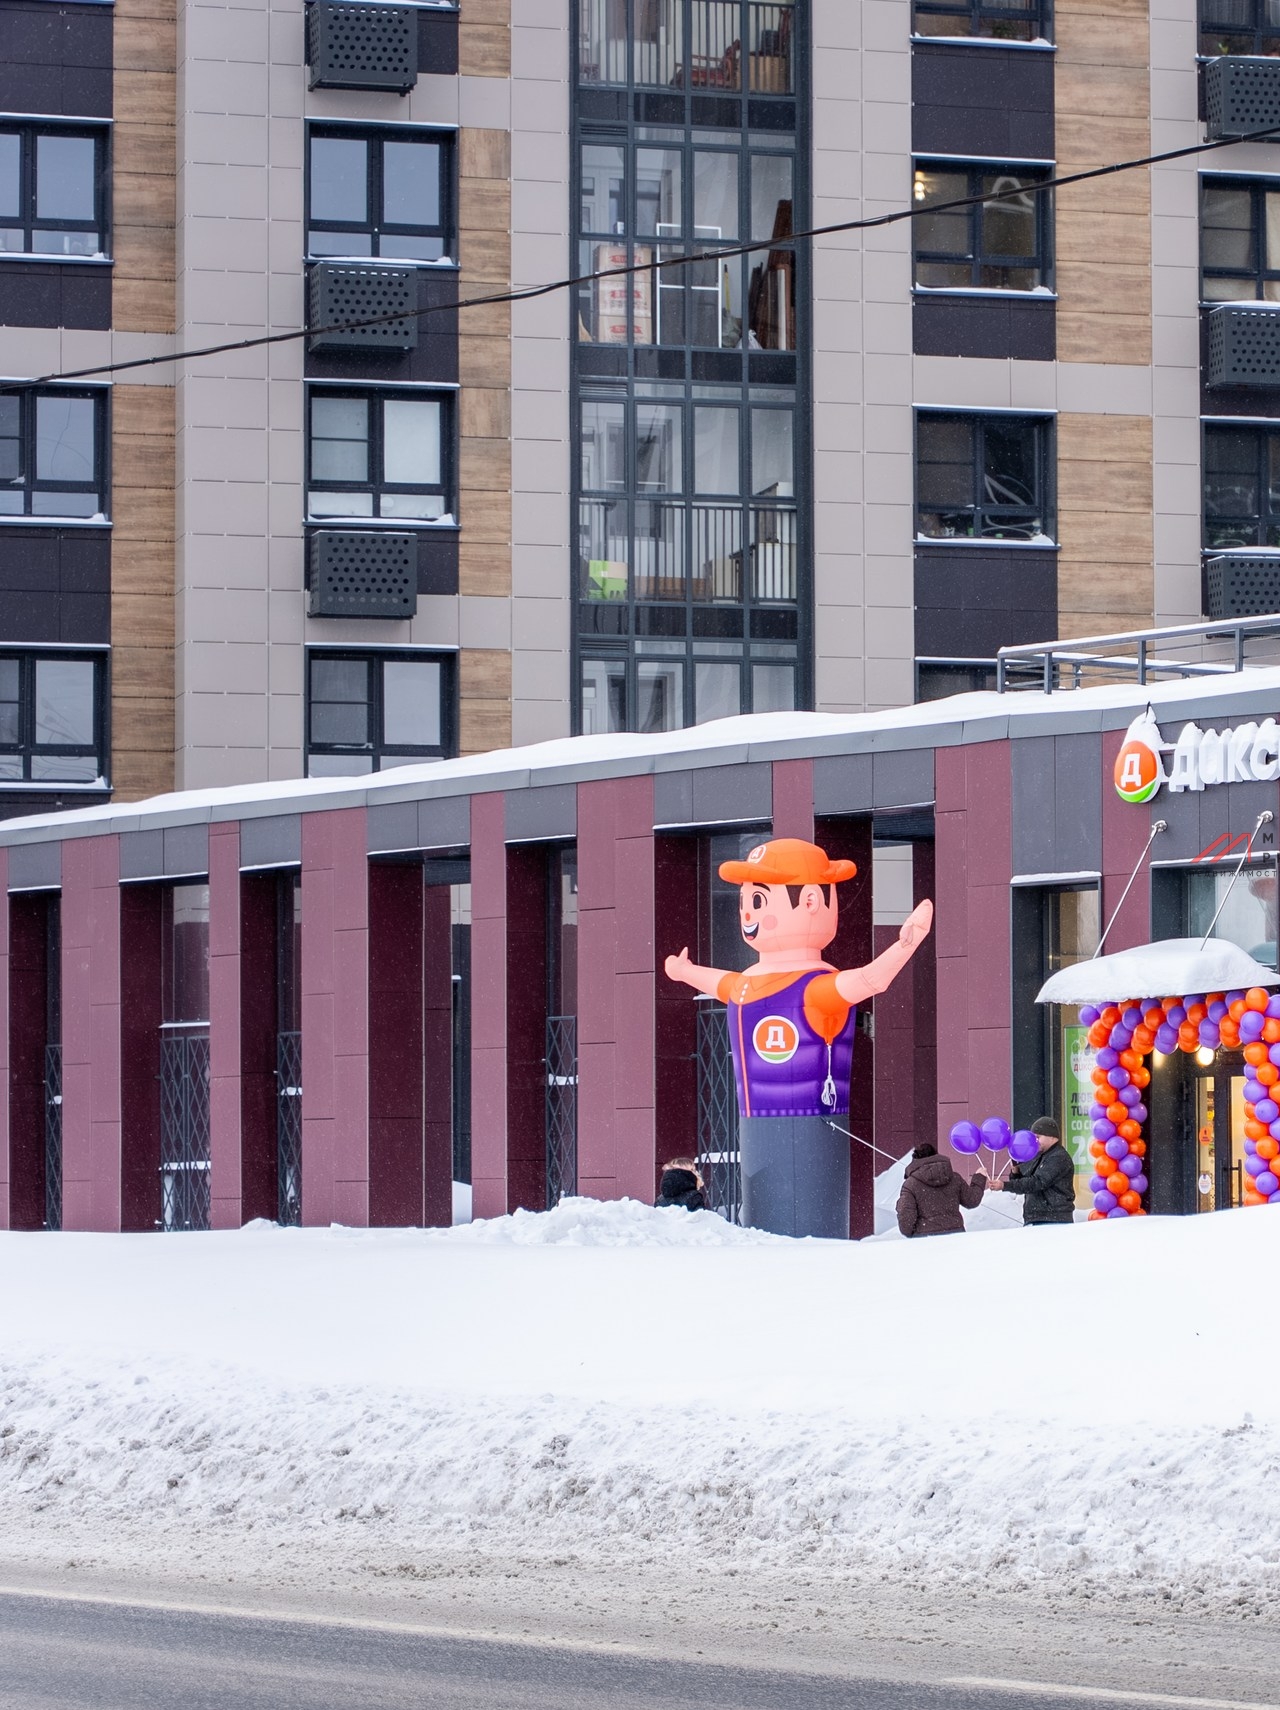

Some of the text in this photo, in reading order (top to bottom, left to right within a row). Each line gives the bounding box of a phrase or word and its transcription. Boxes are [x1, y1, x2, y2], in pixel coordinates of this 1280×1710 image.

[1120, 753, 1142, 788] Д
[765, 1026, 786, 1048] Д
[1071, 1092, 1093, 1104] ЛЮБ
